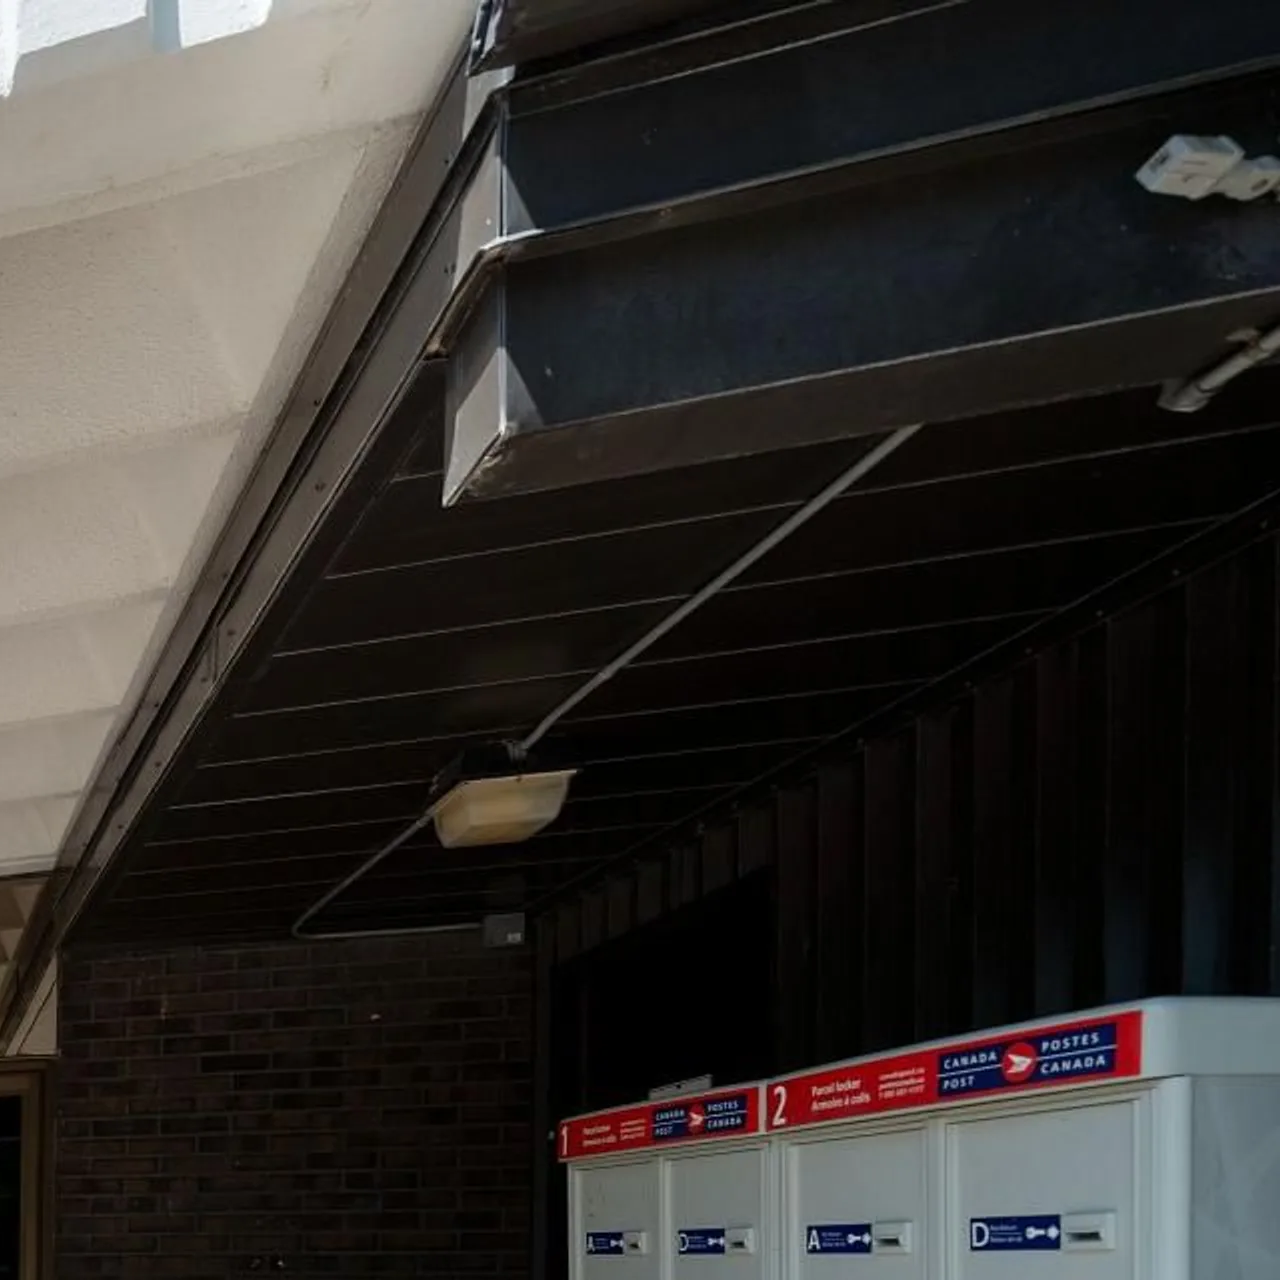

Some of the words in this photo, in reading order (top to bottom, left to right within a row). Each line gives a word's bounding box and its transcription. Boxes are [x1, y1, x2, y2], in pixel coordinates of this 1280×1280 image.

[1042, 1031, 1100, 1053] POSTES
[943, 1051, 998, 1070] CANADA
[1041, 1055, 1106, 1075] CANADA
[943, 1075, 976, 1090] POST
[772, 1085, 787, 1127] 2
[808, 1229, 821, 1250] A
[972, 1222, 990, 1248] D
